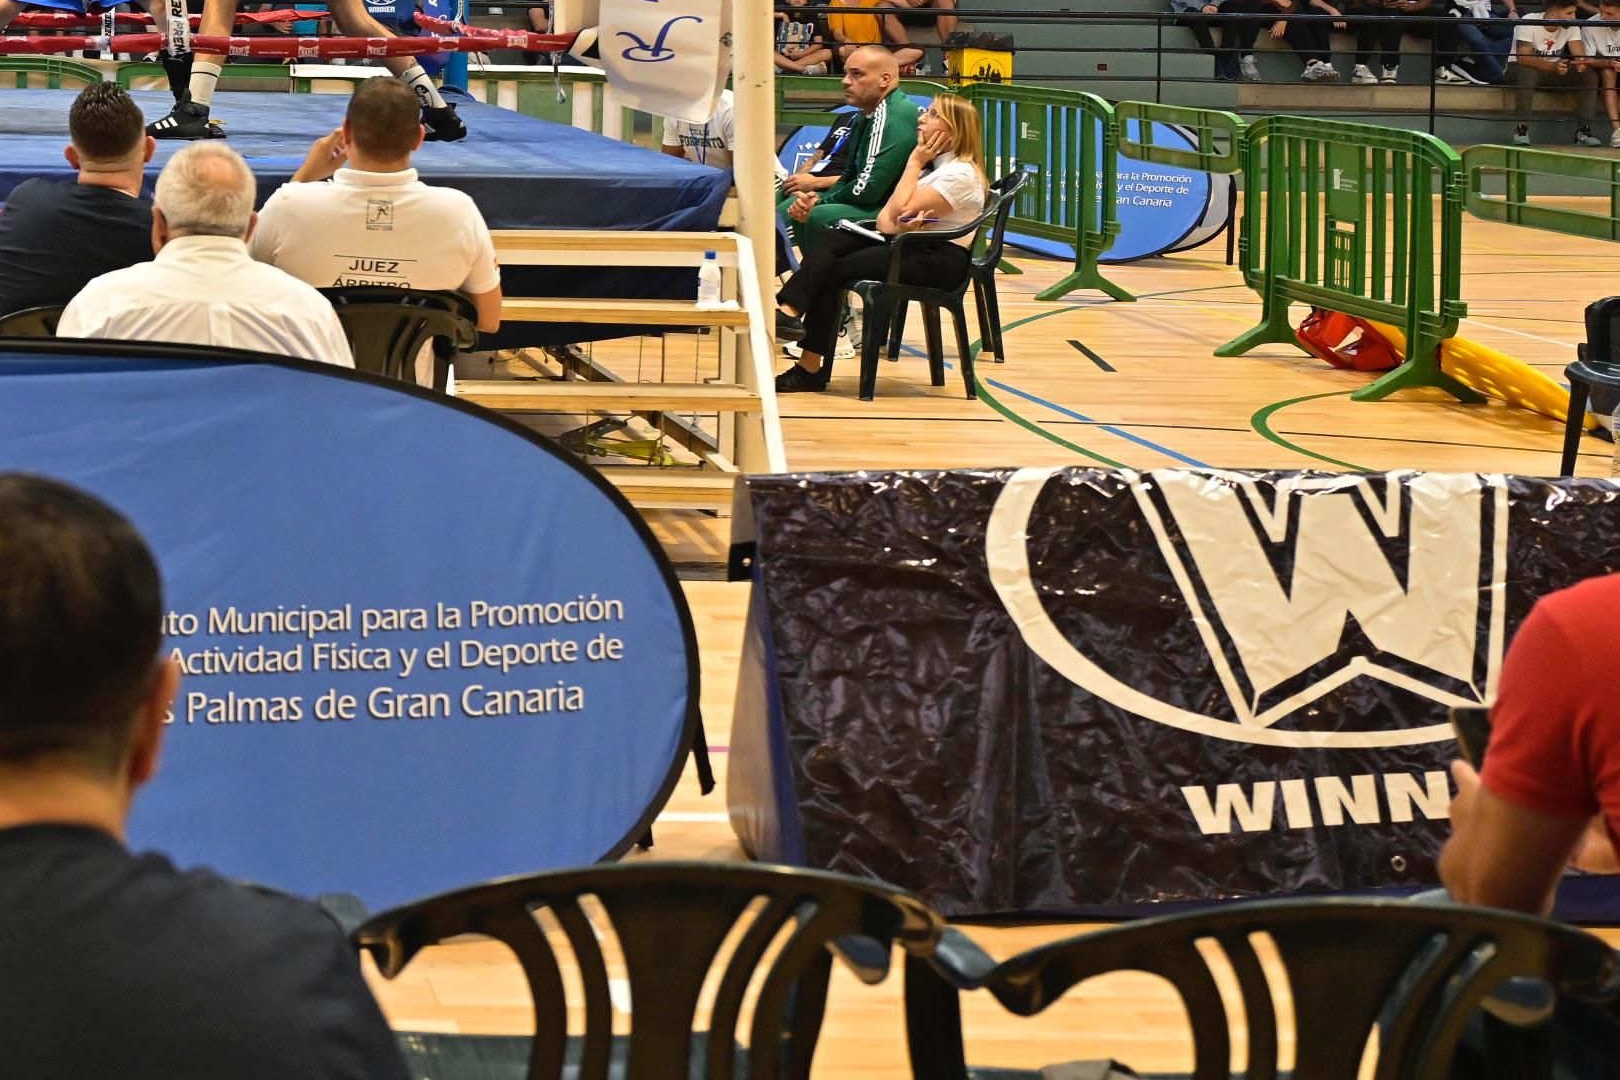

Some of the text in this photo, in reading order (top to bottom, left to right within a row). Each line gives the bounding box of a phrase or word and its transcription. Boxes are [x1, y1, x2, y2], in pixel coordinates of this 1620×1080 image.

[852, 156, 875, 195] adidas
[1116, 172, 1192, 184] ara la Promoción
[1124, 183, 1134, 191] el
[1135, 184, 1175, 195] Deporte
[1176, 185, 1189, 195] de
[1132, 196, 1173, 208] Canaria
[349, 260, 399, 273] JUEZ
[208, 604, 352, 639] Municipal
[361, 608, 428, 639] para
[436, 602, 462, 629] la
[470, 594, 625, 629] Promoción
[169, 633, 625, 678] Actividad Física y el Deporte de
[187, 691, 303, 724] Palmas
[314, 688, 357, 721] de
[367, 687, 451, 719] Gran
[460, 681, 585, 718] Canaria
[1180, 771, 1452, 835] WINN
